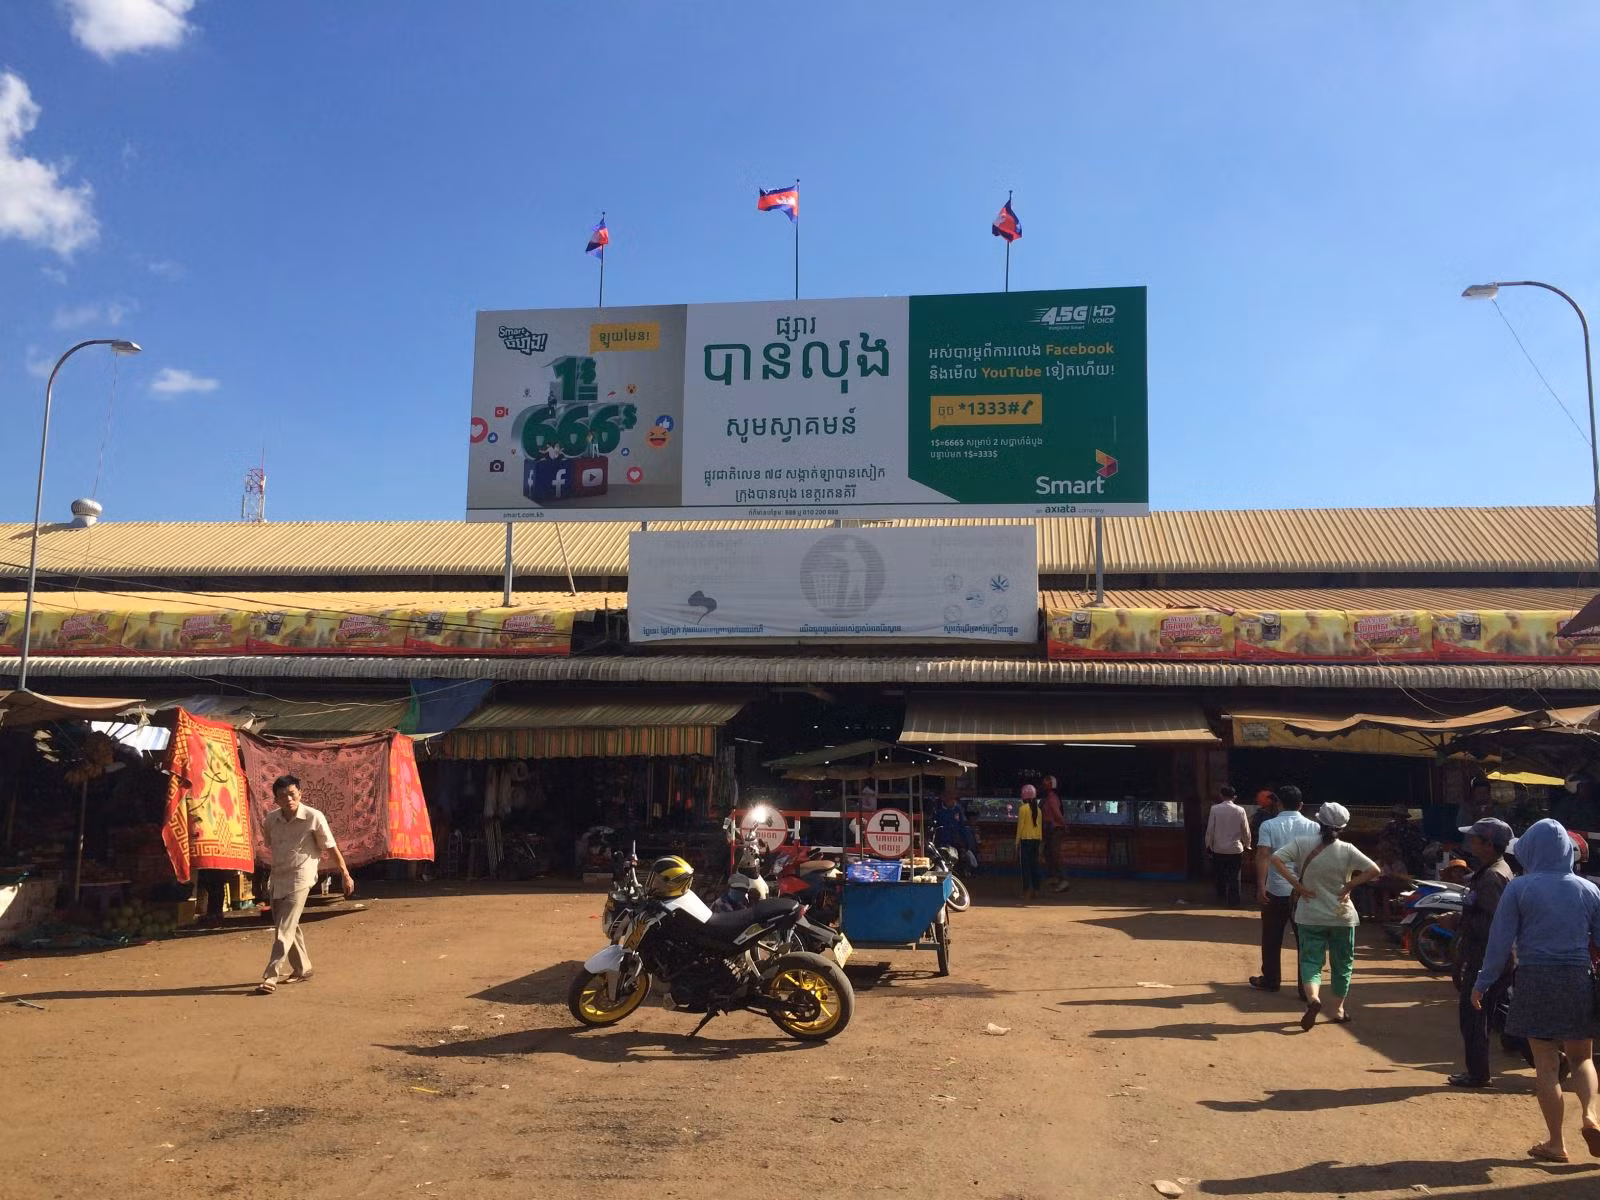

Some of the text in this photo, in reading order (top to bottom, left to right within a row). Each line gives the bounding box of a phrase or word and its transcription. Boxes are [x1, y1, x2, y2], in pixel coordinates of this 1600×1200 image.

[1040, 306, 1088, 325] 4.5G
[1093, 305, 1116, 317] HD
[499, 326, 525, 338] Smart
[776, 316, 816, 342] ផ្សារ
[1046, 342, 1115, 356] Facebook
[703, 332, 890, 394] បានលុង
[982, 365, 1042, 379] YouTube
[726, 406, 857, 444] សូមស្វាគមន៍
[993, 438, 999, 446] 2
[765, 468, 782, 480] ៧៨
[1035, 475, 1105, 495] Smart
[1044, 504, 1077, 514] axiata
